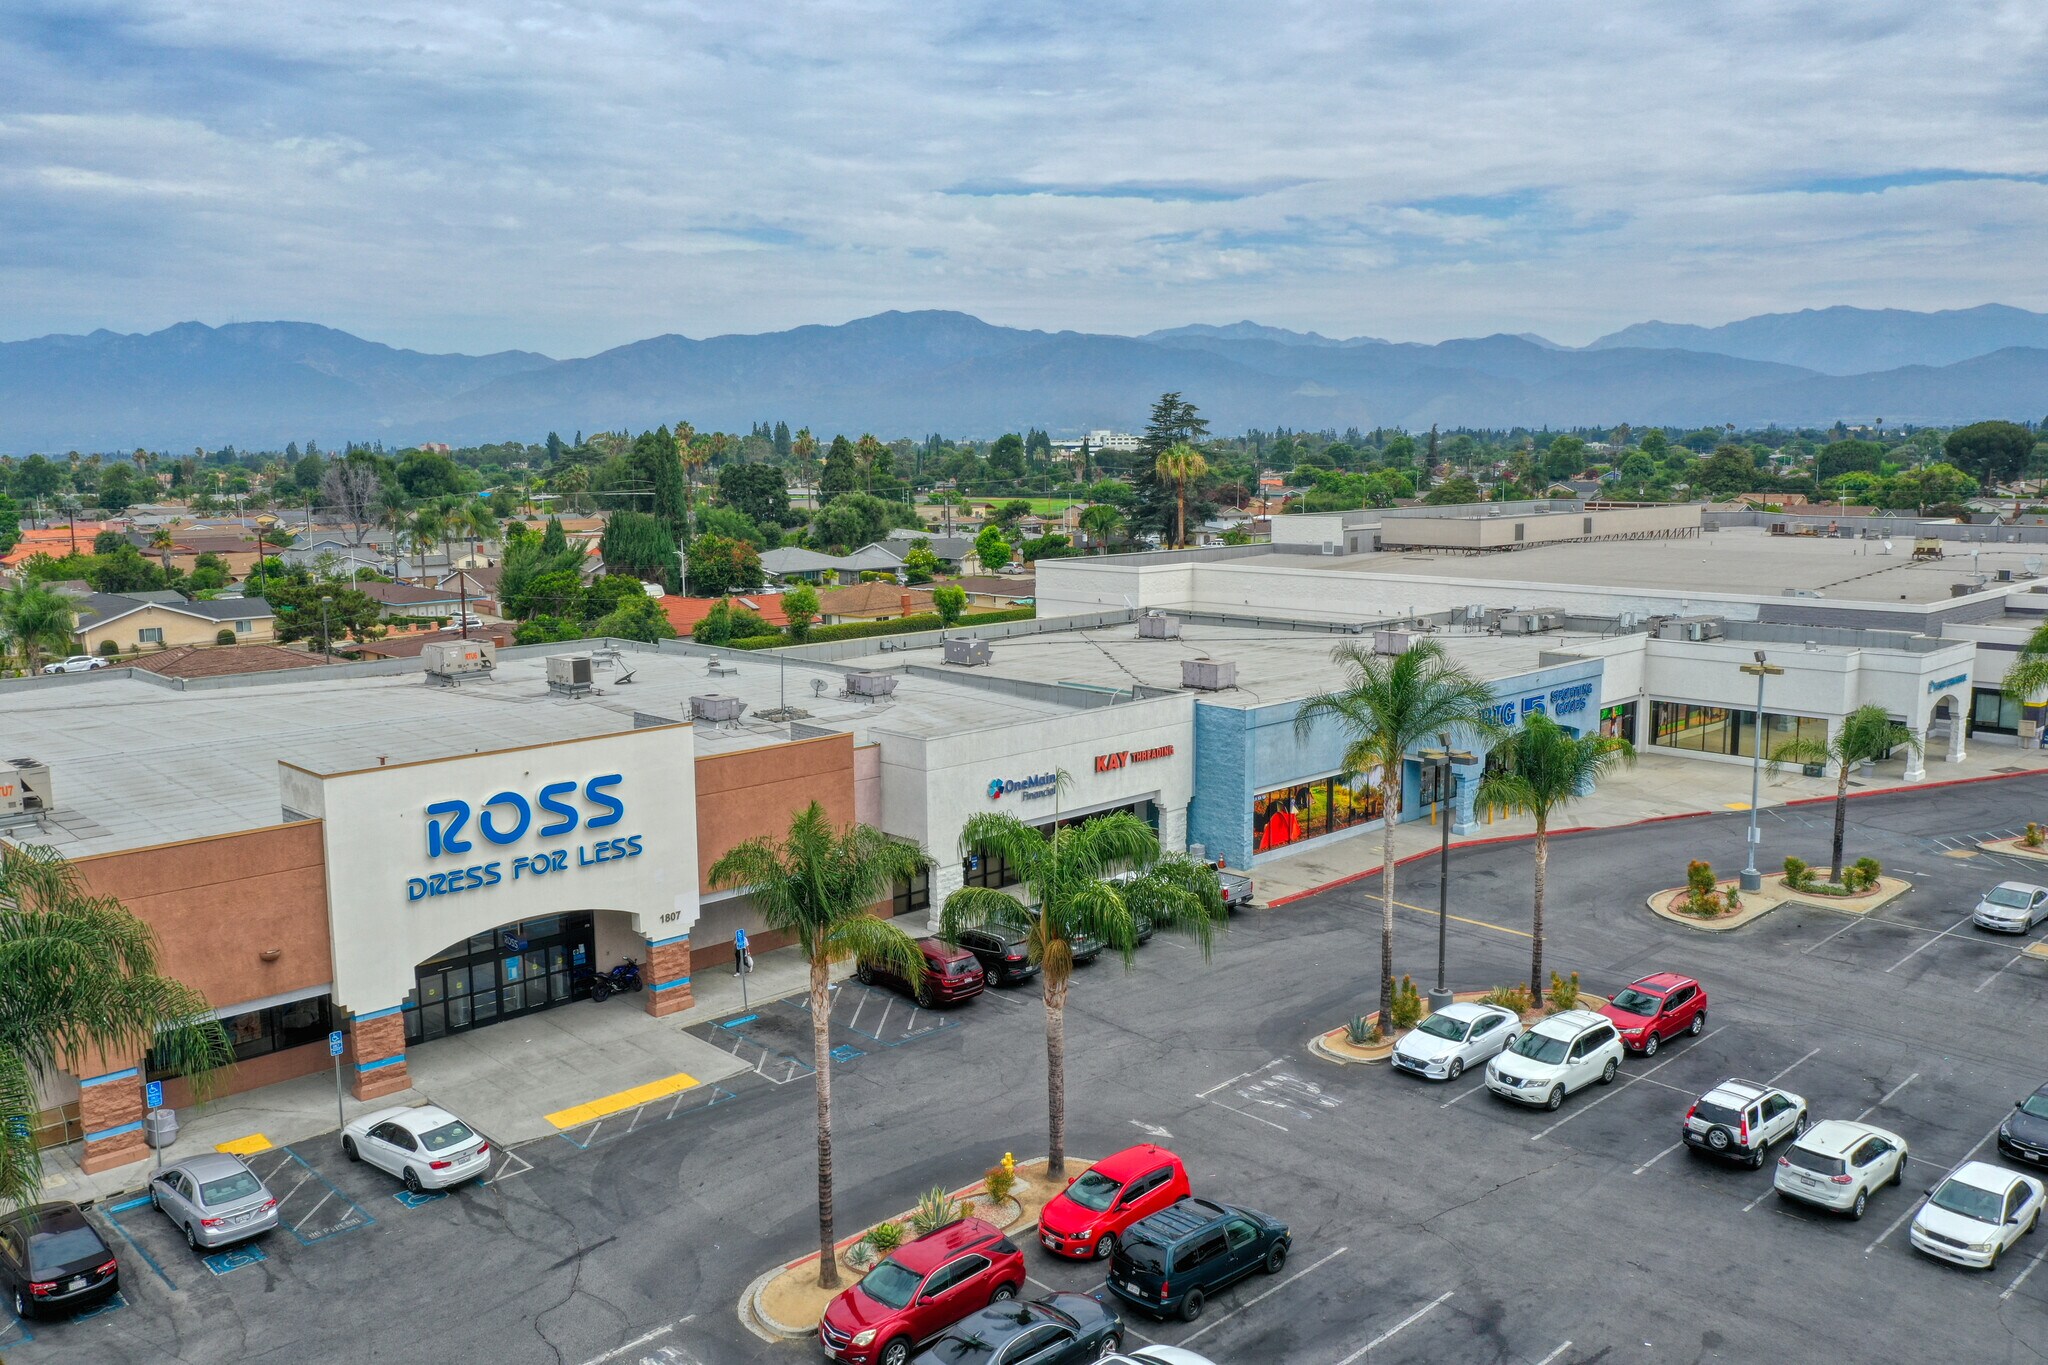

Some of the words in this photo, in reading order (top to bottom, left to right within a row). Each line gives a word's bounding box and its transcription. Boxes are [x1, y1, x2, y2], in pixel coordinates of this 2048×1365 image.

[1550, 683, 1593, 703] SPORTING
[1480, 702, 1515, 726] BIG
[1522, 695, 1546, 716] 5
[1555, 698, 1586, 716] GOODS
[1095, 750, 1129, 773] KAY
[1131, 745, 1174, 762] THREADING
[1005, 772, 1056, 792] OneMain
[1022, 786, 1056, 801] Financial
[425, 773, 624, 858] ROSS
[408, 861, 502, 902] DRESS
[512, 849, 568, 879] FOR
[578, 834, 643, 867] LESS
[659, 910, 681, 924] 1807
[503, 935, 519, 949] ROSS
